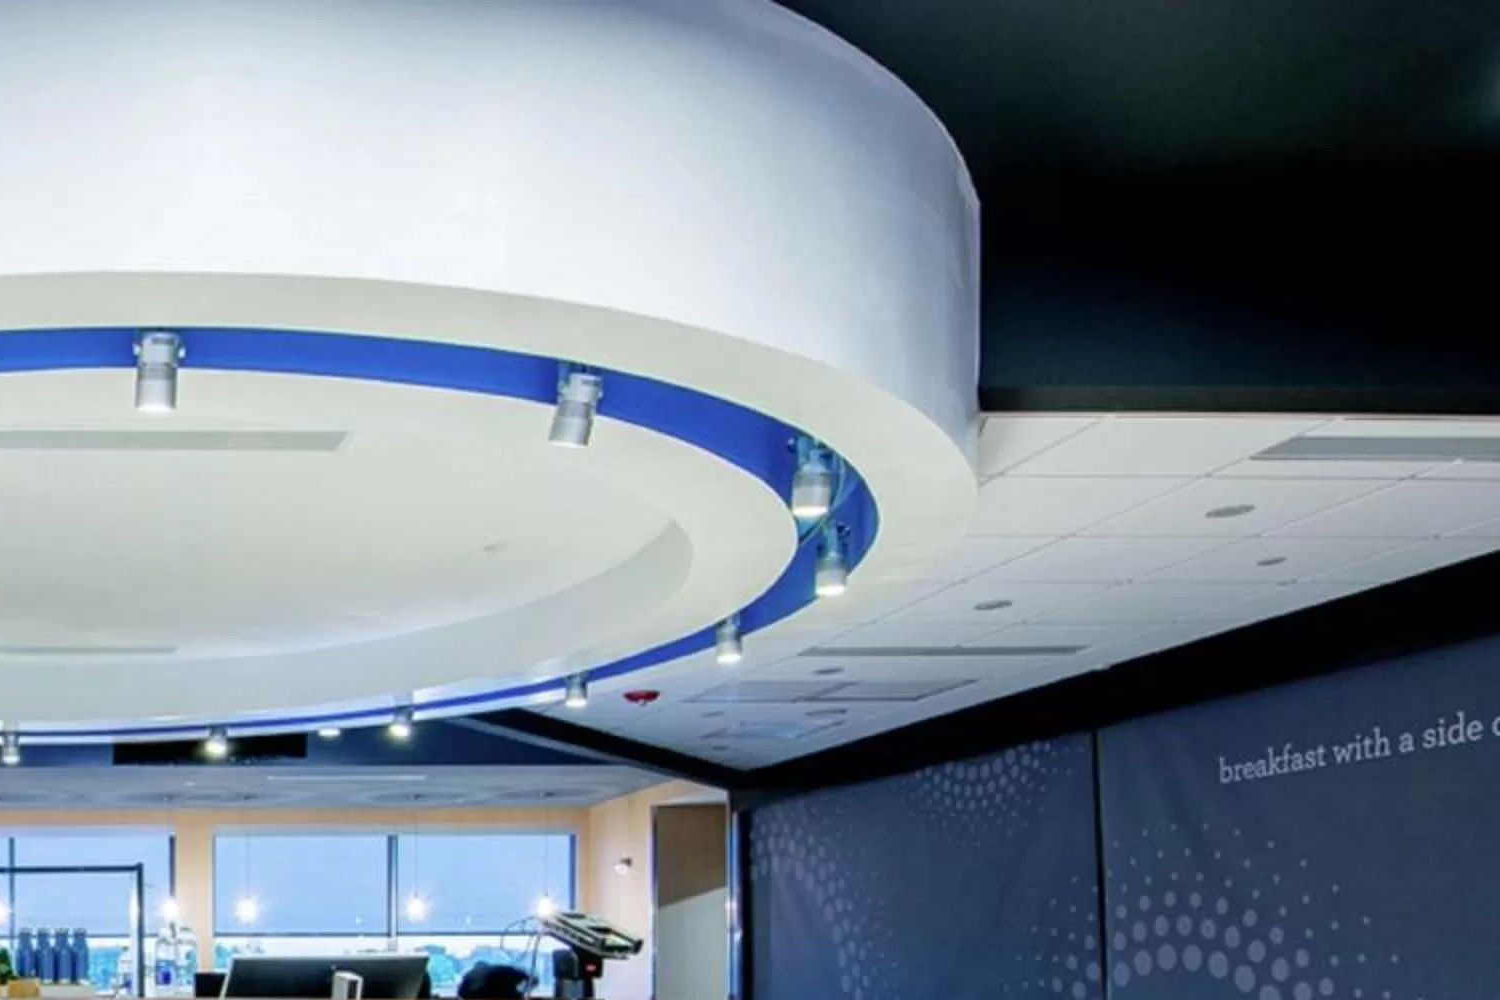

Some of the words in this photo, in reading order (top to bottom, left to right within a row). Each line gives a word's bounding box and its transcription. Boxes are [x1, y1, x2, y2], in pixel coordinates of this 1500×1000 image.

[1219, 743, 1327, 784] breakfast
[1332, 726, 1392, 764] with
[1399, 731, 1415, 753] a
[1422, 710, 1484, 749] side
